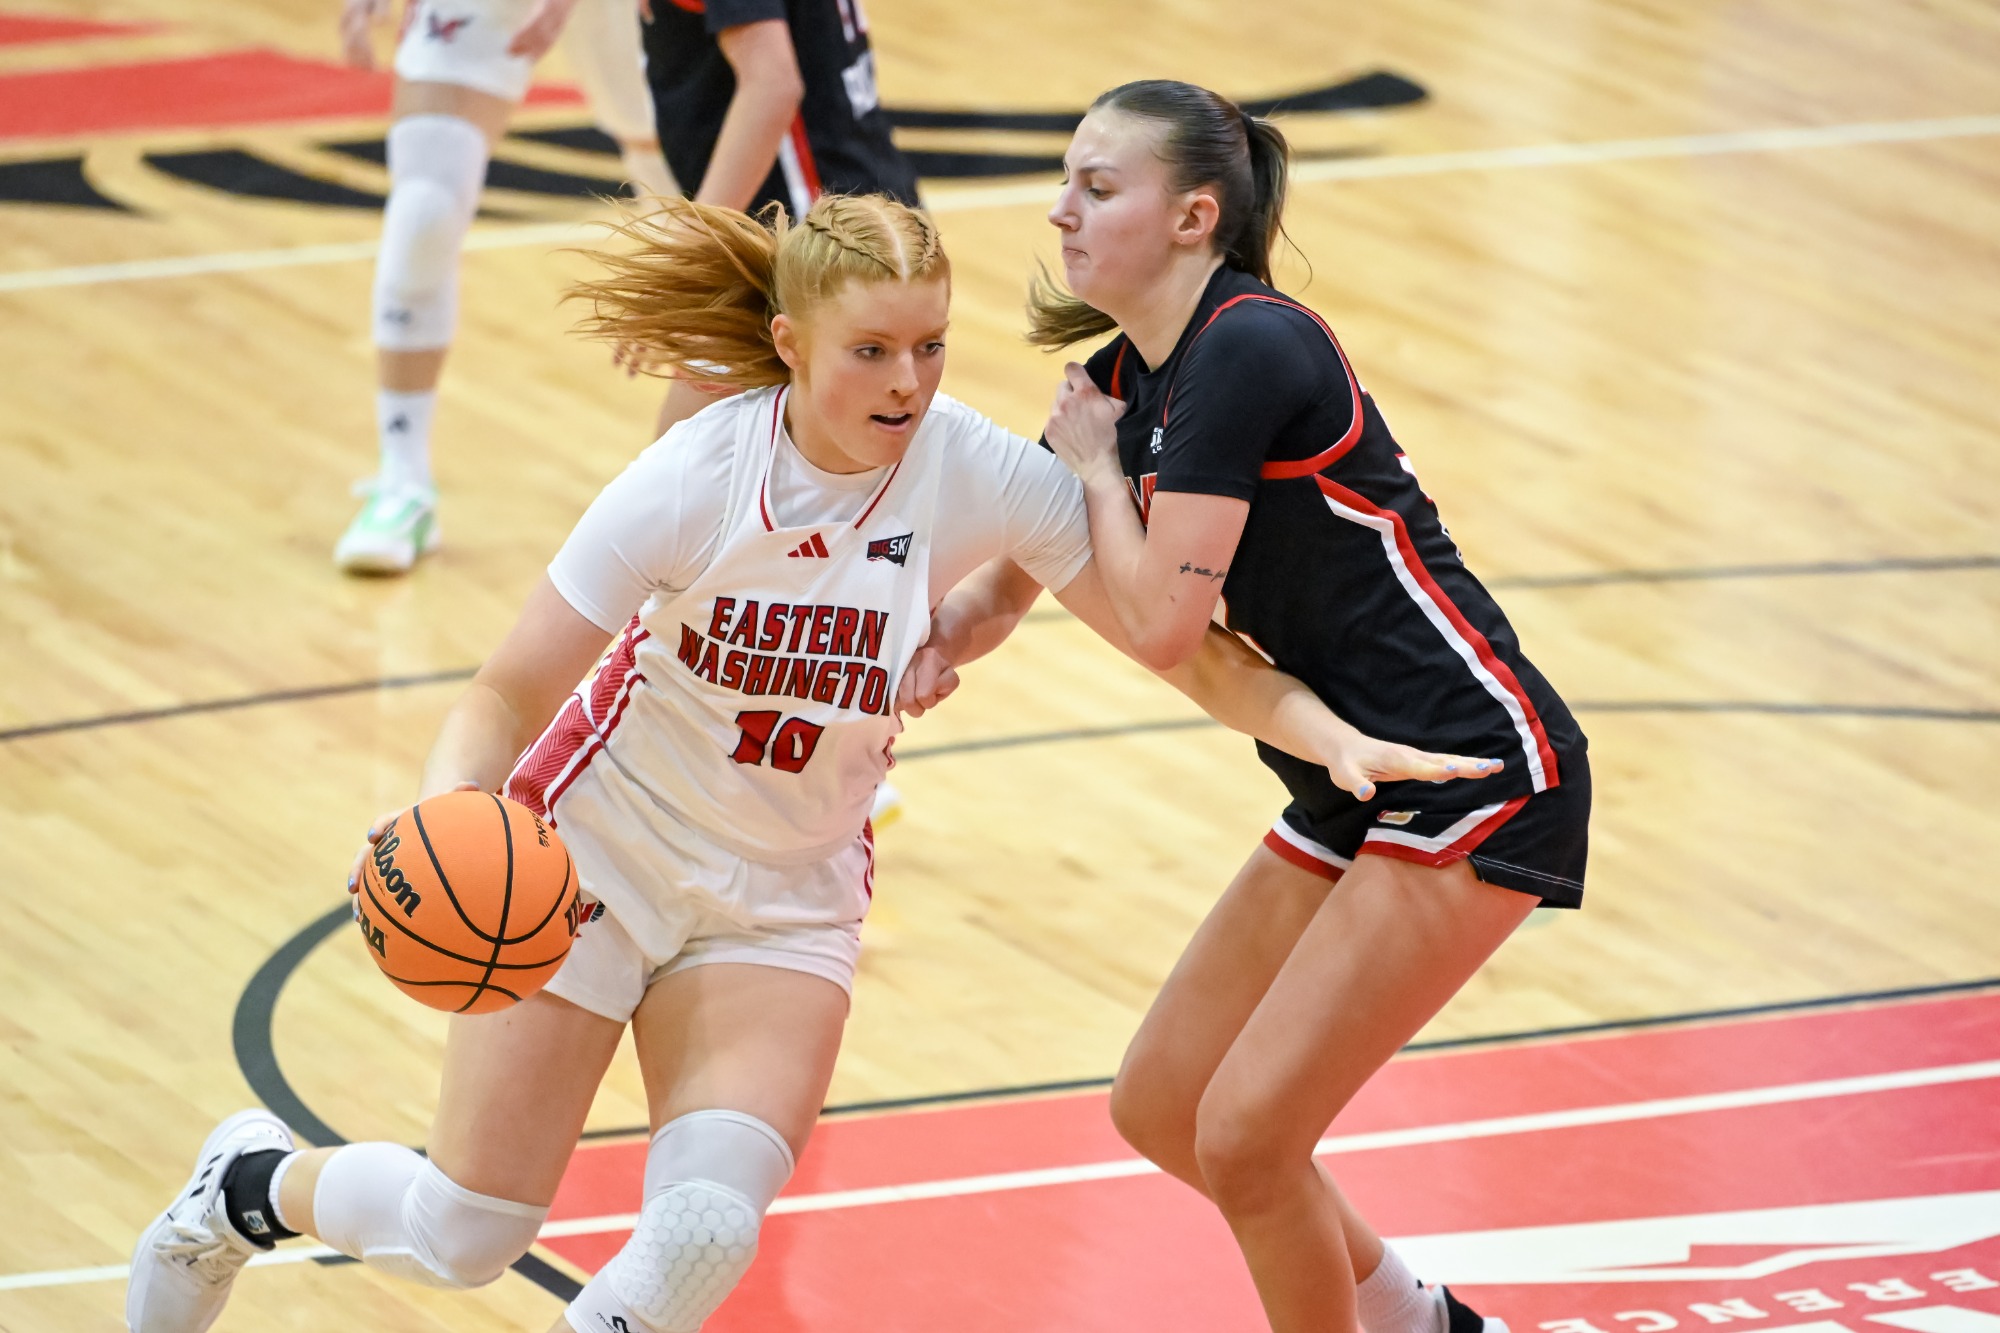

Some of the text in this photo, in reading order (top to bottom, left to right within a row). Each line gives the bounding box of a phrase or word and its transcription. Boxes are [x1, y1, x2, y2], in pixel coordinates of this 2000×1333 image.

[707, 596, 890, 661] EASTERN
[728, 711, 825, 774] 10
[373, 817, 421, 918] ilson
